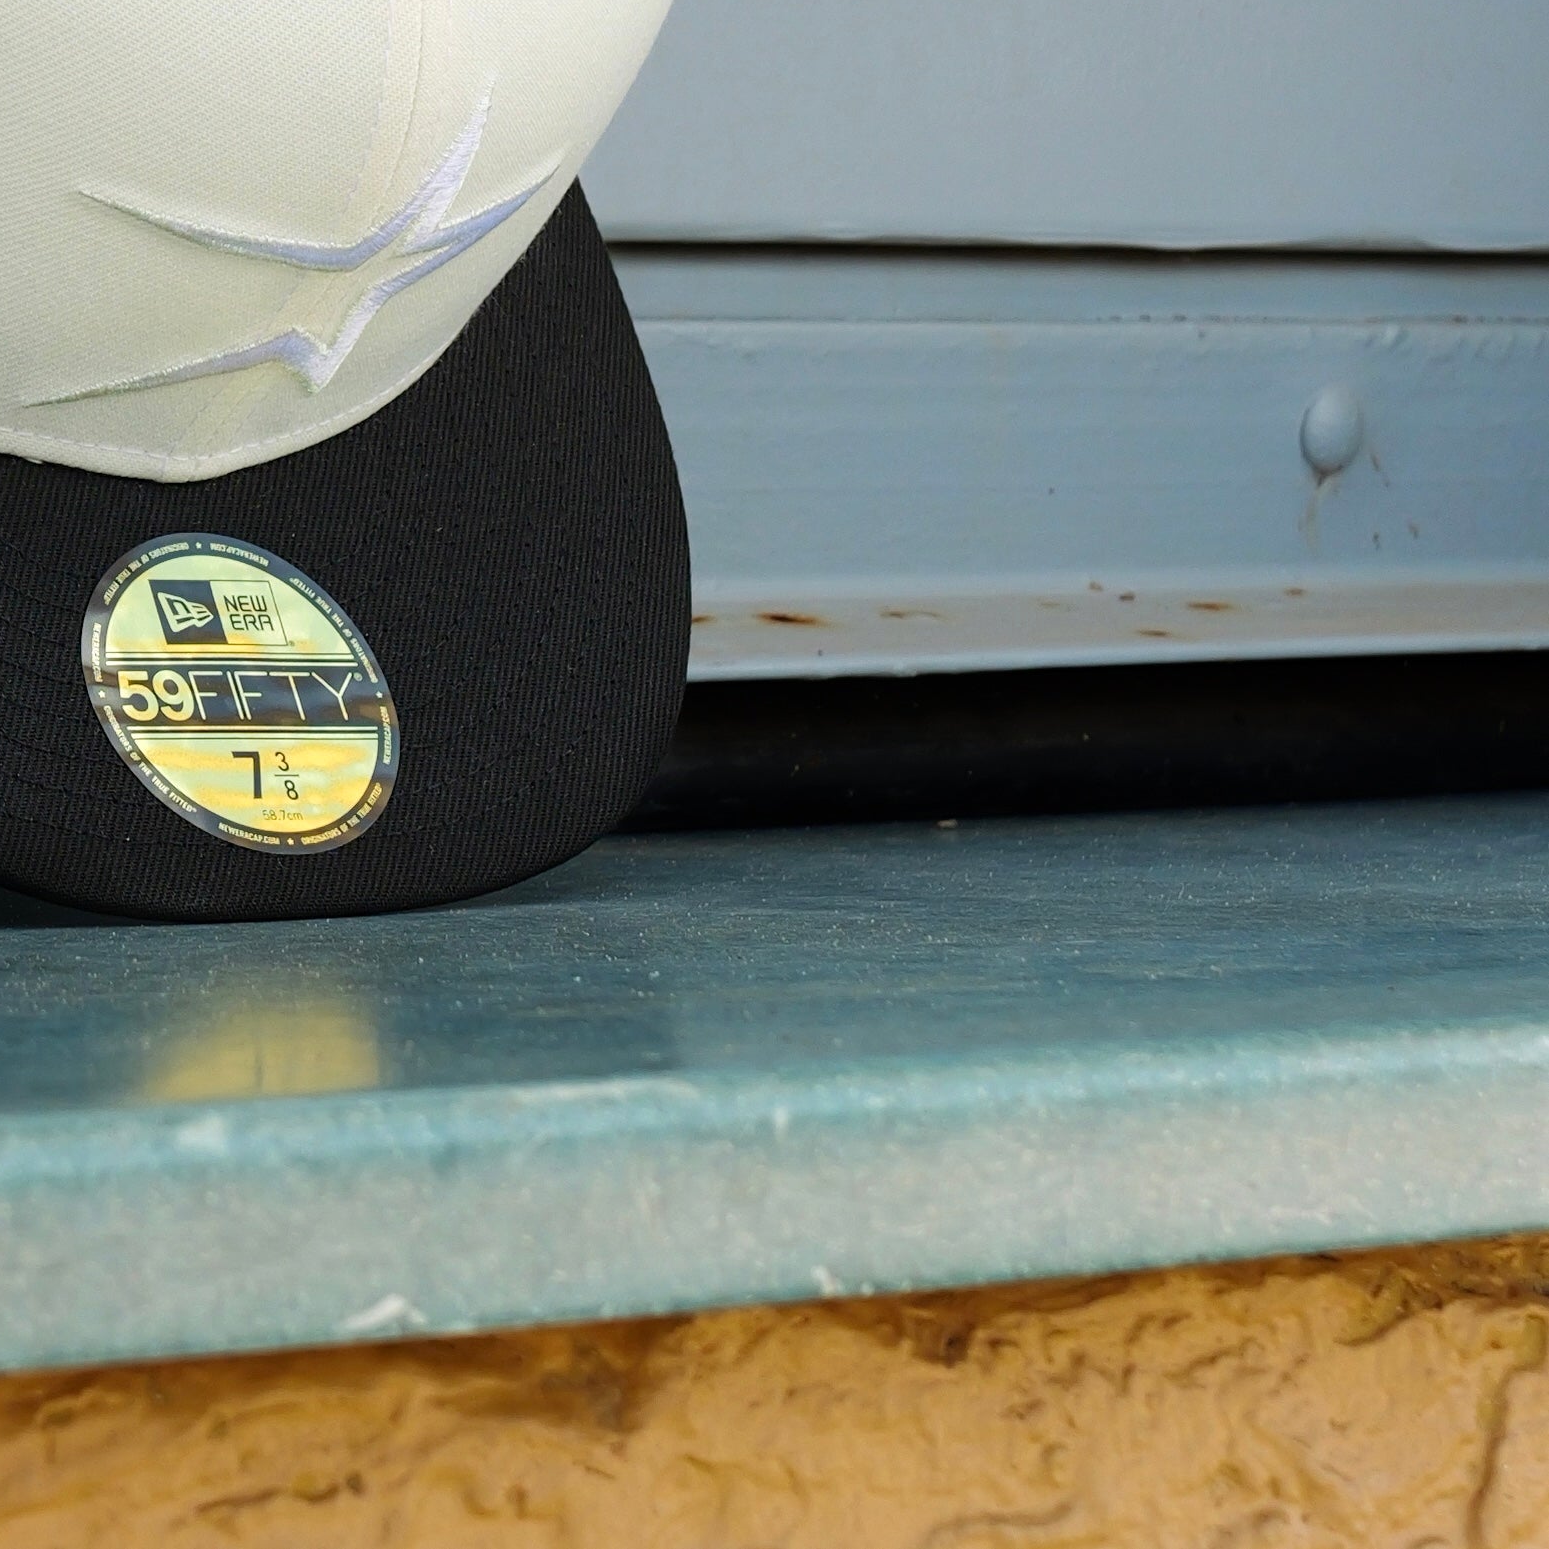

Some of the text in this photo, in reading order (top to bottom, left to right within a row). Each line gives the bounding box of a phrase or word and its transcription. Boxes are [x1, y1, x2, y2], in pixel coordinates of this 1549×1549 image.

[223, 595, 268, 613] NEW
[315, 596, 333, 614] TRUE
[230, 614, 275, 631] ERA
[116, 668, 354, 721] 59FIFTY
[138, 761, 152, 778] THE
[151, 775, 170, 795] TRUE
[231, 751, 263, 799] 7
[262, 809, 304, 821] 58.7cm
